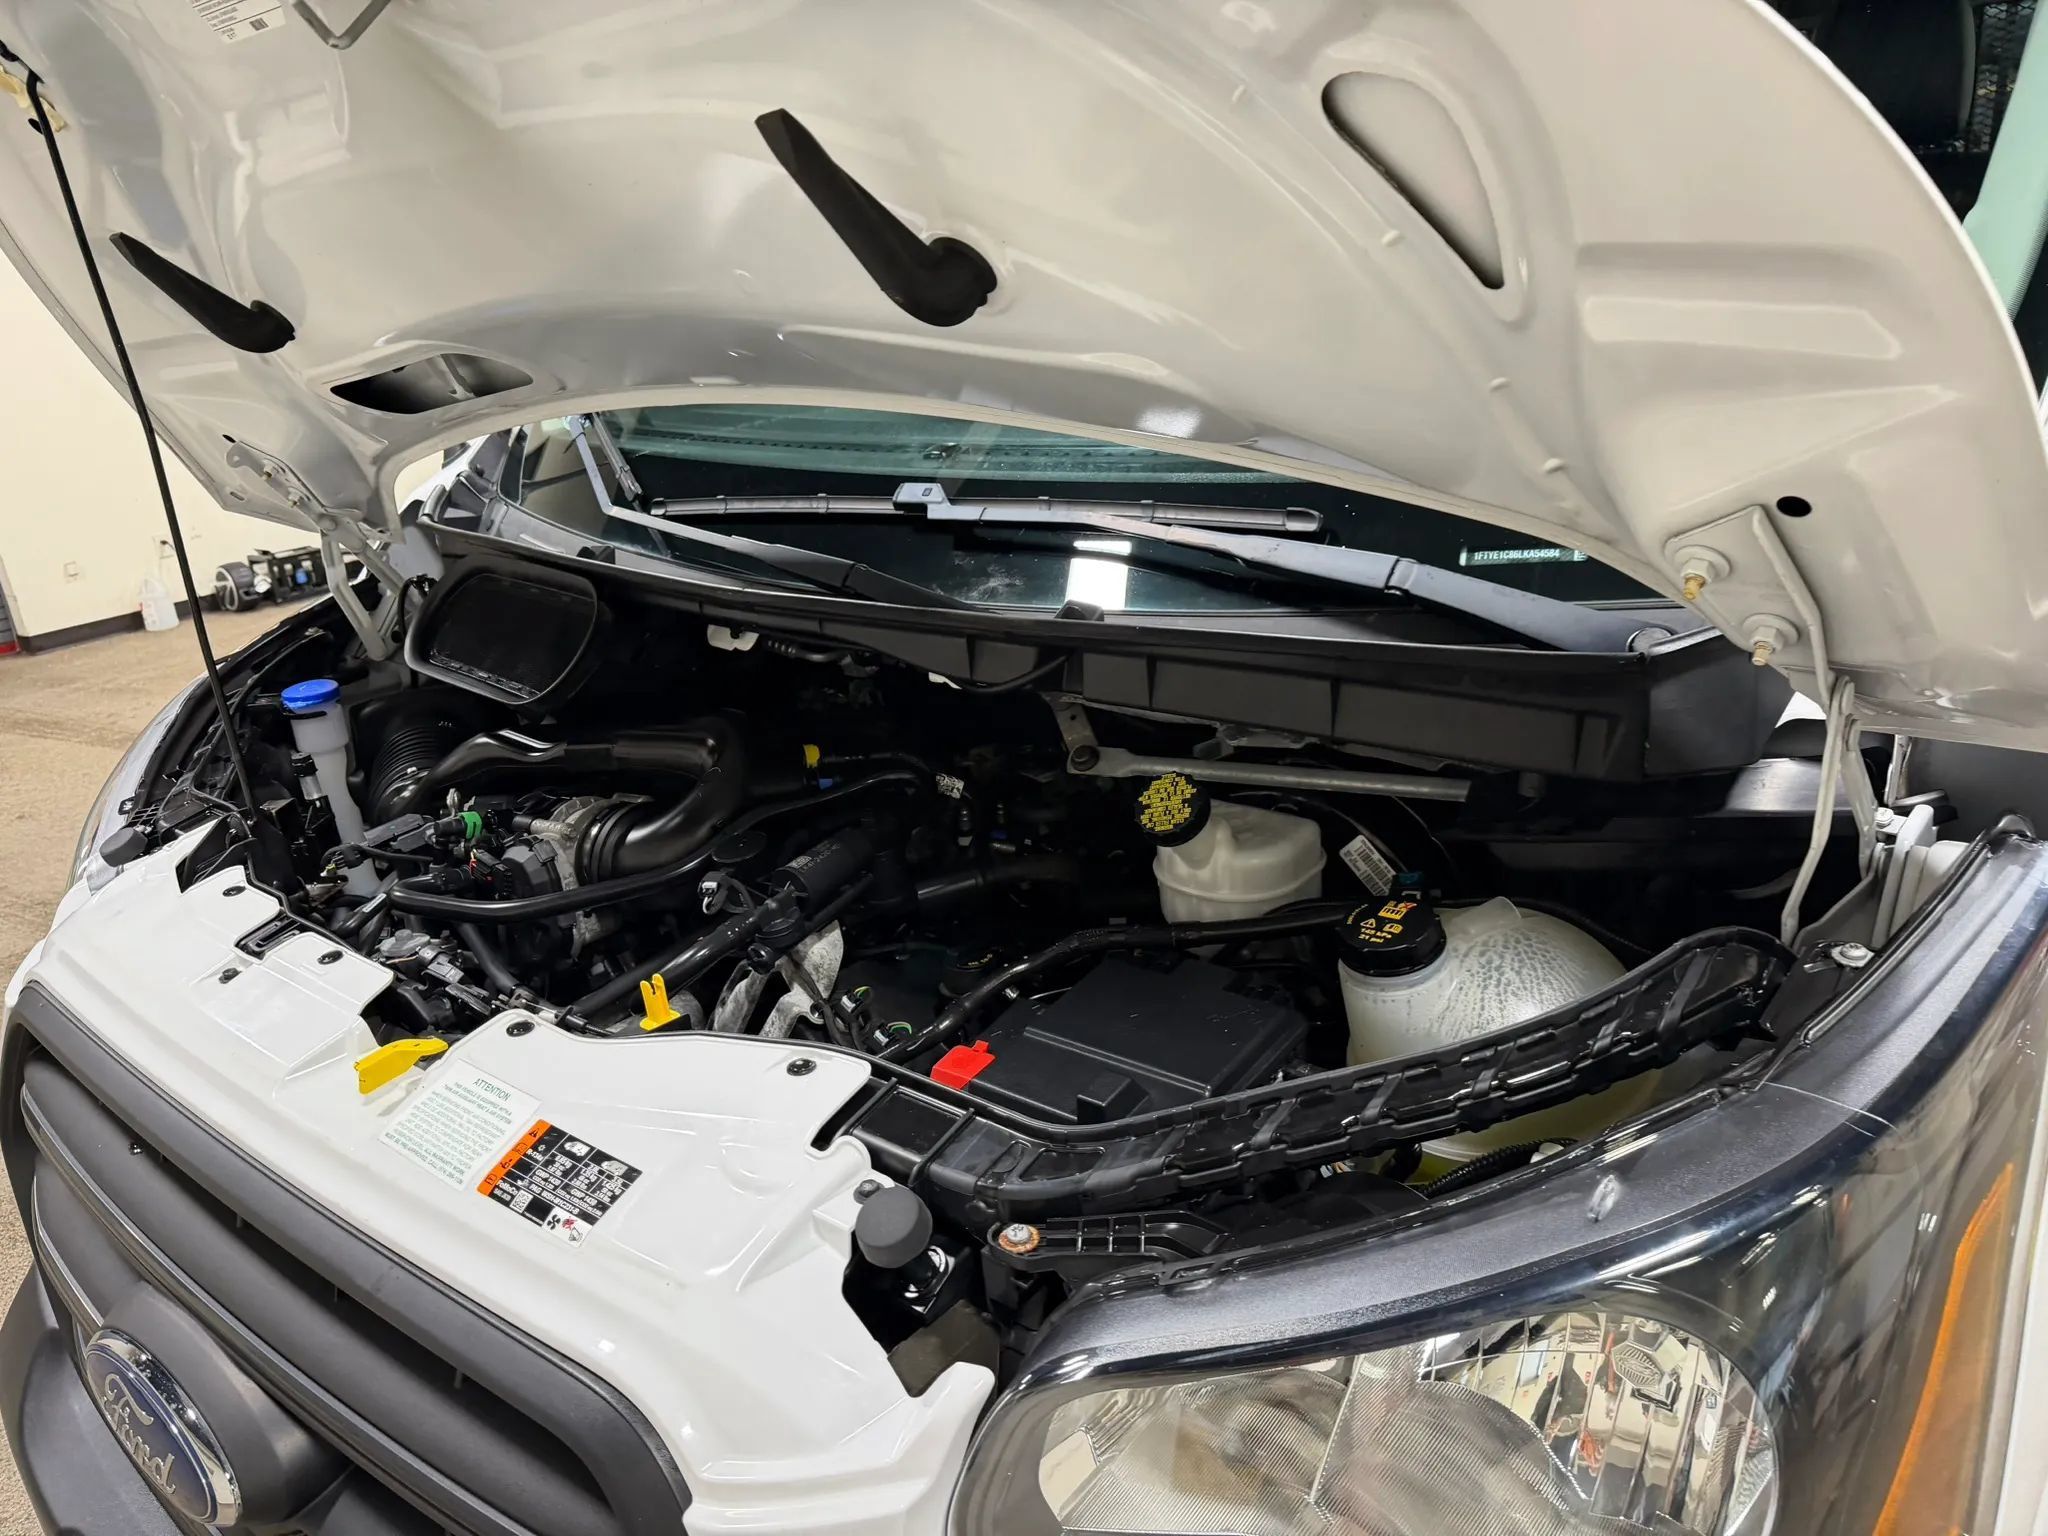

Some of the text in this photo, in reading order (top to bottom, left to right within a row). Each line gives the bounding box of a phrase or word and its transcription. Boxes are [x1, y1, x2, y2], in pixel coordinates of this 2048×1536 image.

[1474, 548, 1560, 560] 1FTYE1C86LKA54584
[1376, 931, 1392, 939] kPa
[461, 1087, 478, 1097] VEHICLE
[472, 1078, 512, 1101] ATTENTION
[526, 1149, 545, 1161] R-134a
[535, 1170, 550, 1180] GWP
[496, 1180, 519, 1196] FoMoCo
[529, 1184, 542, 1194] PAG
[571, 1189, 585, 1199] GWP
[103, 1373, 176, 1495] Ford
